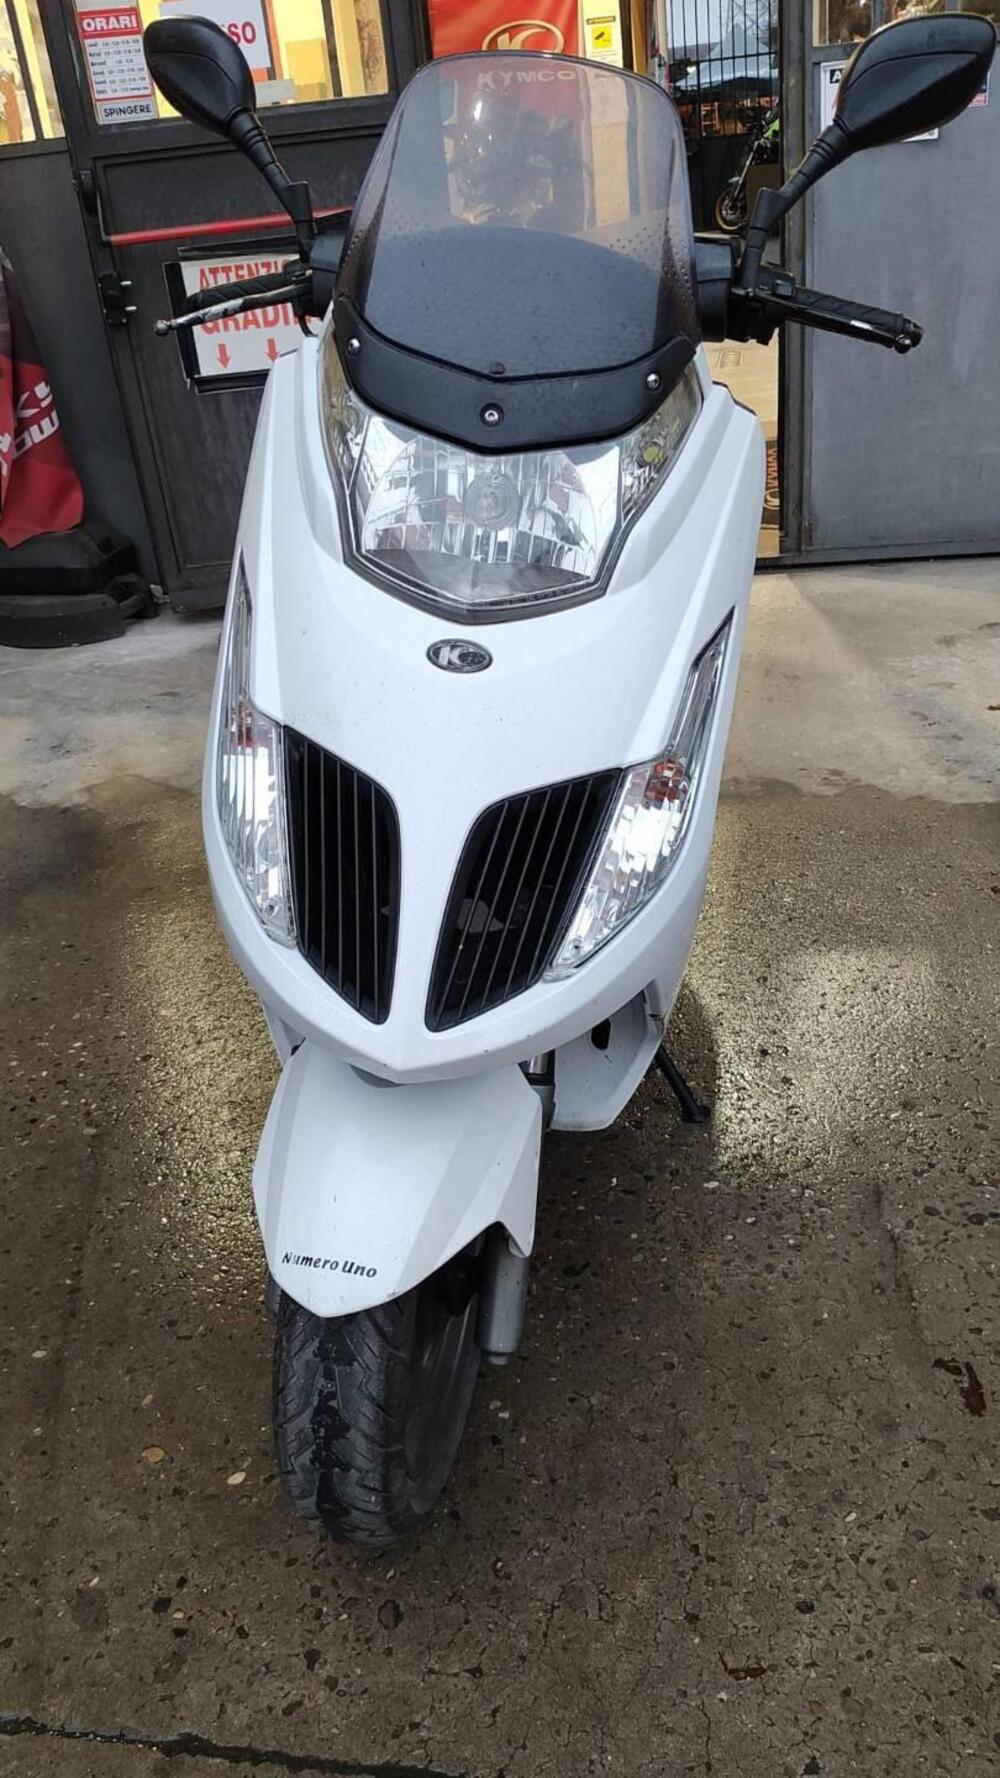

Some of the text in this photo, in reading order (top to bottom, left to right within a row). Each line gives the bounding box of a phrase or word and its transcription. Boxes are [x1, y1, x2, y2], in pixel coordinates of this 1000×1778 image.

[82, 14, 138, 32] ORARI
[227, 20, 257, 45] SO
[477, 69, 577, 89] KYMCO
[102, 104, 152, 118] SPINGERE
[281, 1251, 378, 1278] Numero Uno
